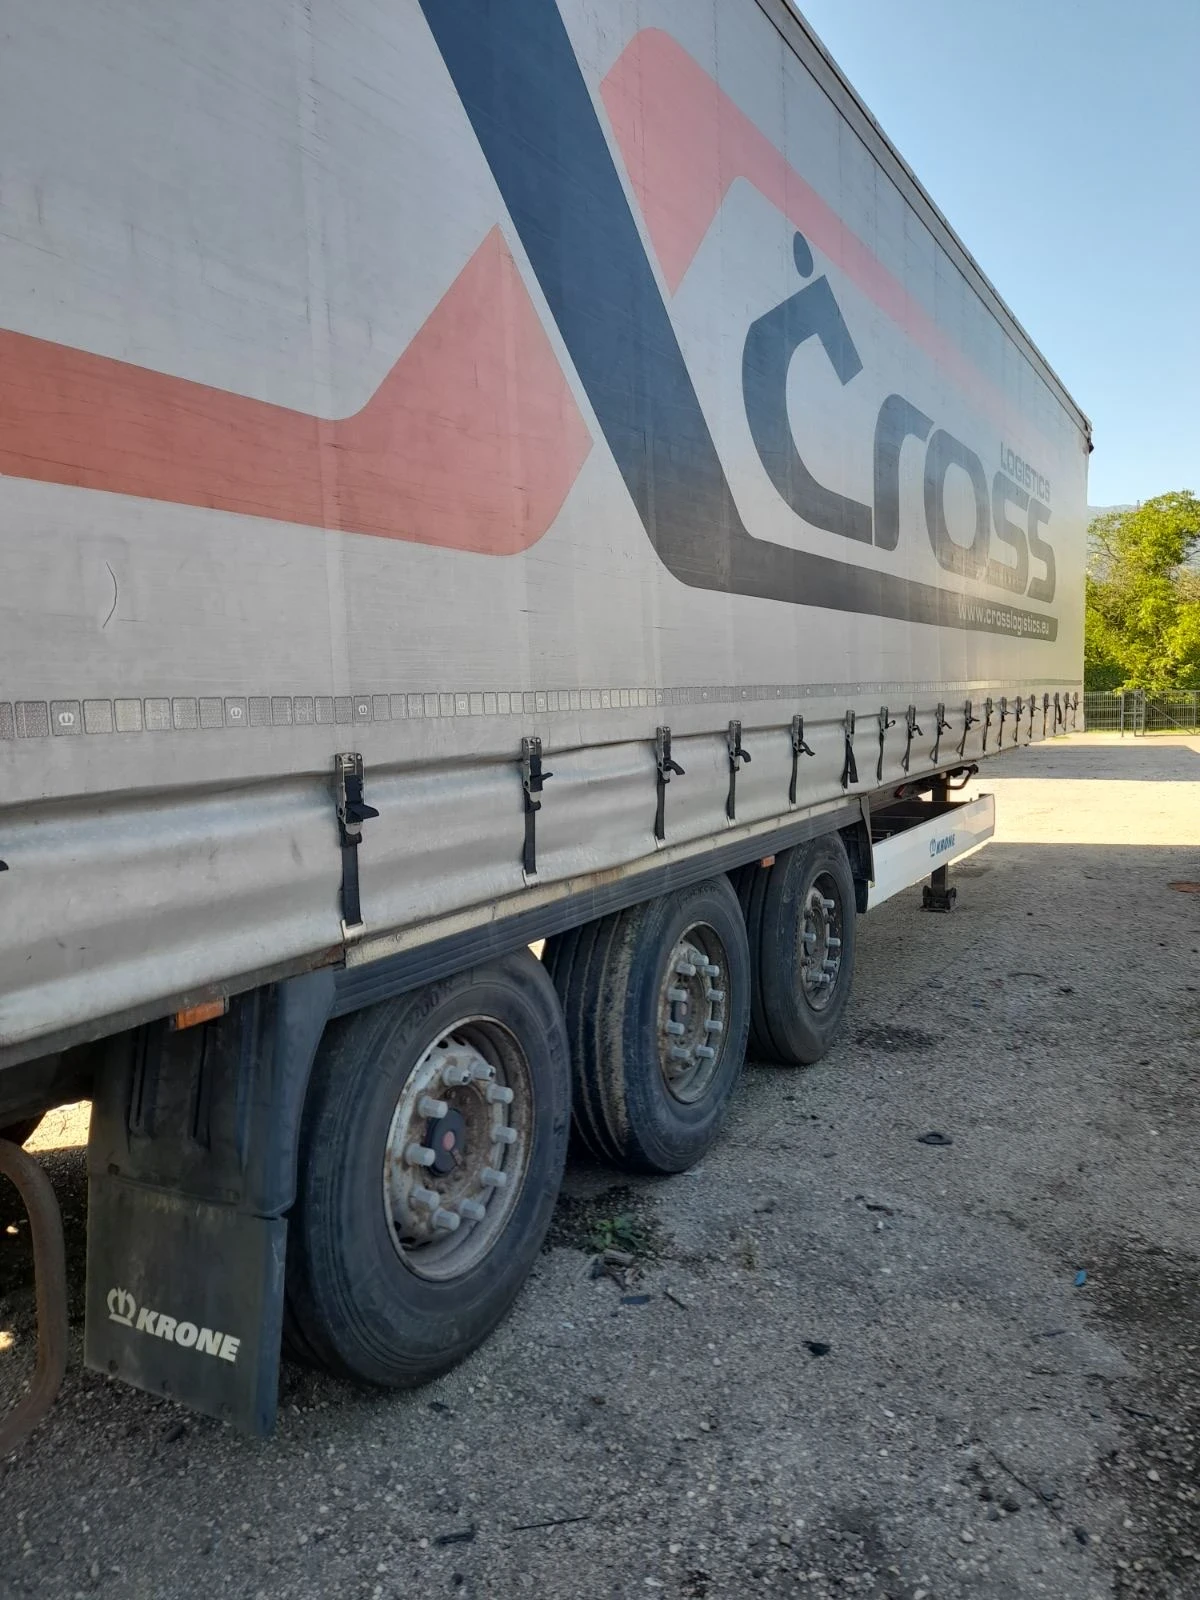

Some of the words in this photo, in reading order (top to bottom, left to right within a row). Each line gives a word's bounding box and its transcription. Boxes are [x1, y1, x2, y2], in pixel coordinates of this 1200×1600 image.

[1001, 440, 1050, 503] LOGISTICS
[958, 603, 1050, 635] www.crosslogistics.eu
[936, 833, 955, 855] KRONE
[136, 1307, 241, 1362] KRONE
